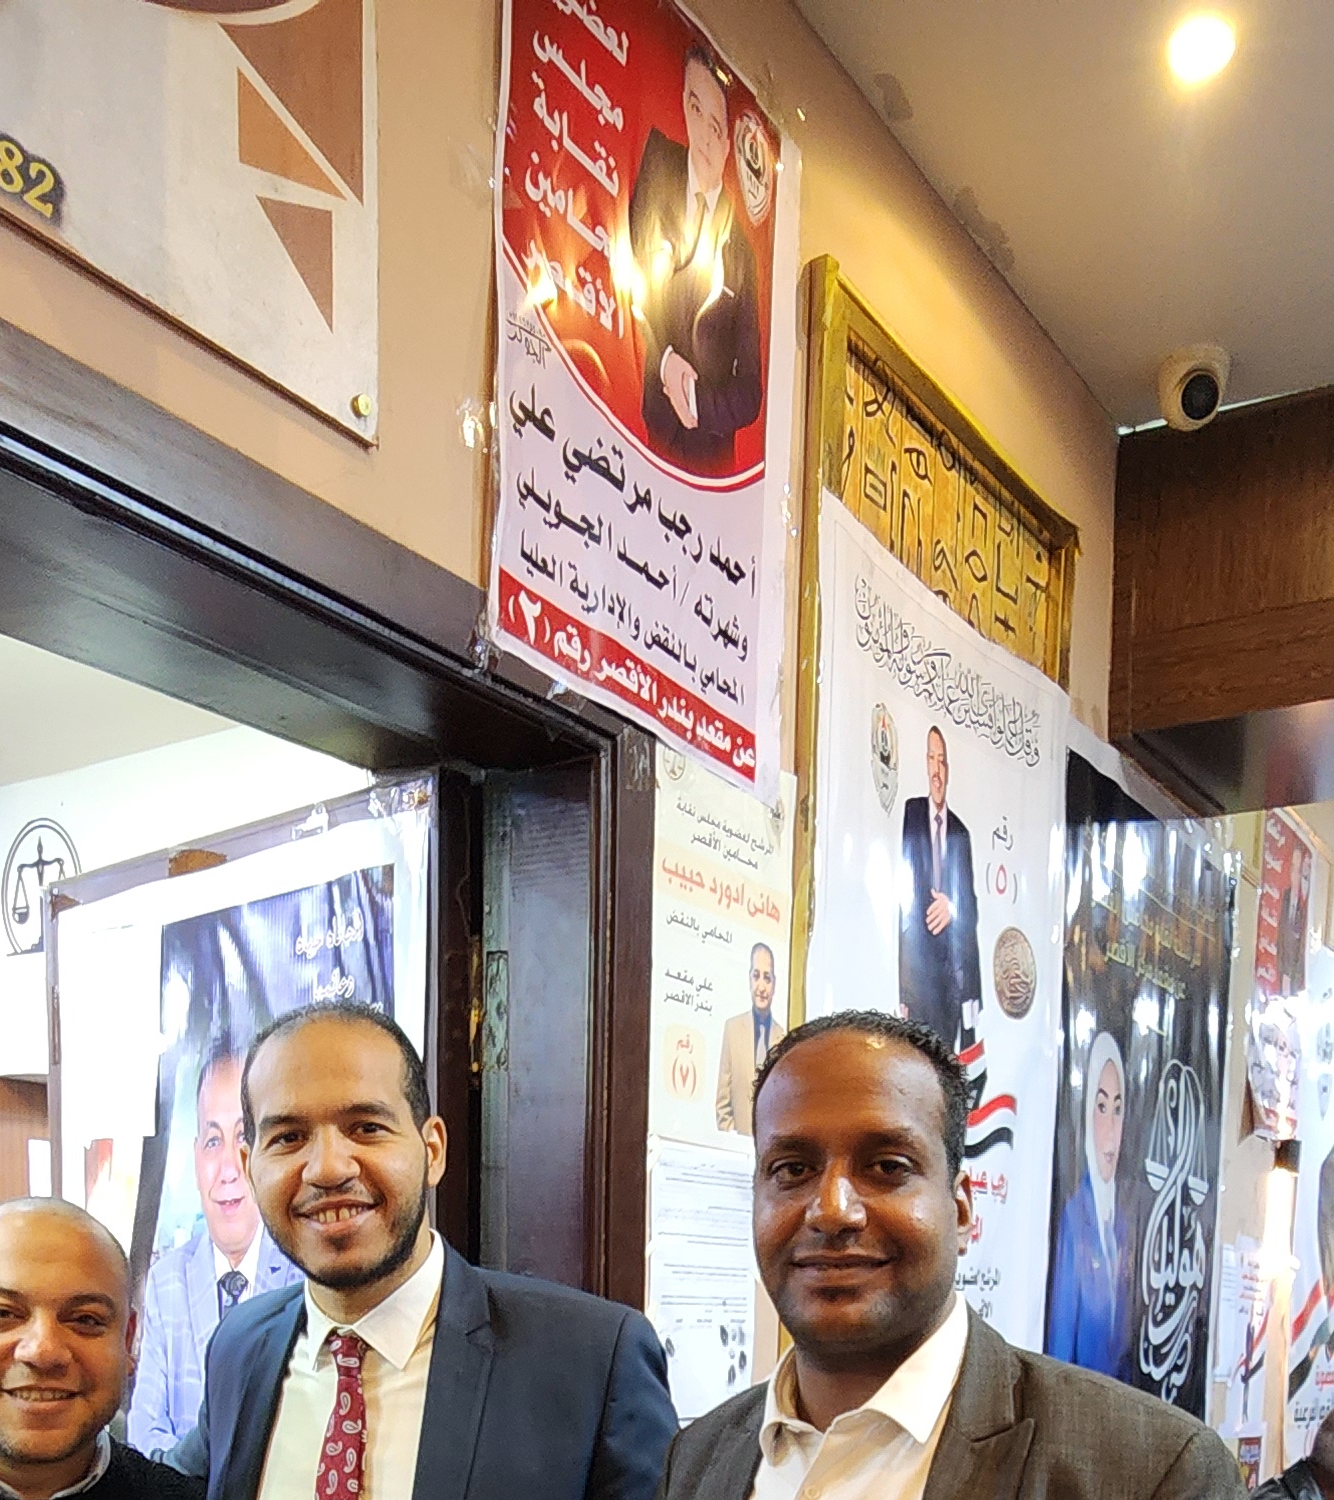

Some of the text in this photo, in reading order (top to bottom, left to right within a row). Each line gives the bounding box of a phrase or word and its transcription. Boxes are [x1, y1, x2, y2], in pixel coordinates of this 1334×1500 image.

[533, 30, 624, 133] مجلس
[531, 70, 620, 198] نقابة
[509, 382, 556, 443] علي
[657, 496, 703, 564] رجب
[617, 535, 678, 602] أحمد
[709, 536, 757, 599] أحمد
[520, 528, 745, 706] المحامي بالنقض والإدارية العليا
[693, 591, 749, 662] وشهرته
[553, 623, 591, 673] رقم
[593, 657, 658, 705] الأقصر
[657, 696, 695, 740] بندر
[695, 715, 732, 752] مقعد
[732, 736, 756, 767] عن
[676, 797, 774, 855] المرشح لعضوية مجلس نقابة
[992, 816, 1014, 853] رقم
[691, 831, 758, 870] محامين الأقصر
[662, 857, 705, 893] حبيب
[666, 910, 733, 944] المحامي بالنقض
[664, 968, 695, 986] مقعد
[694, 999, 713, 1017] بندر
[676, 1033, 694, 1054] رقم
[671, 1055, 697, 1097] (٧)
